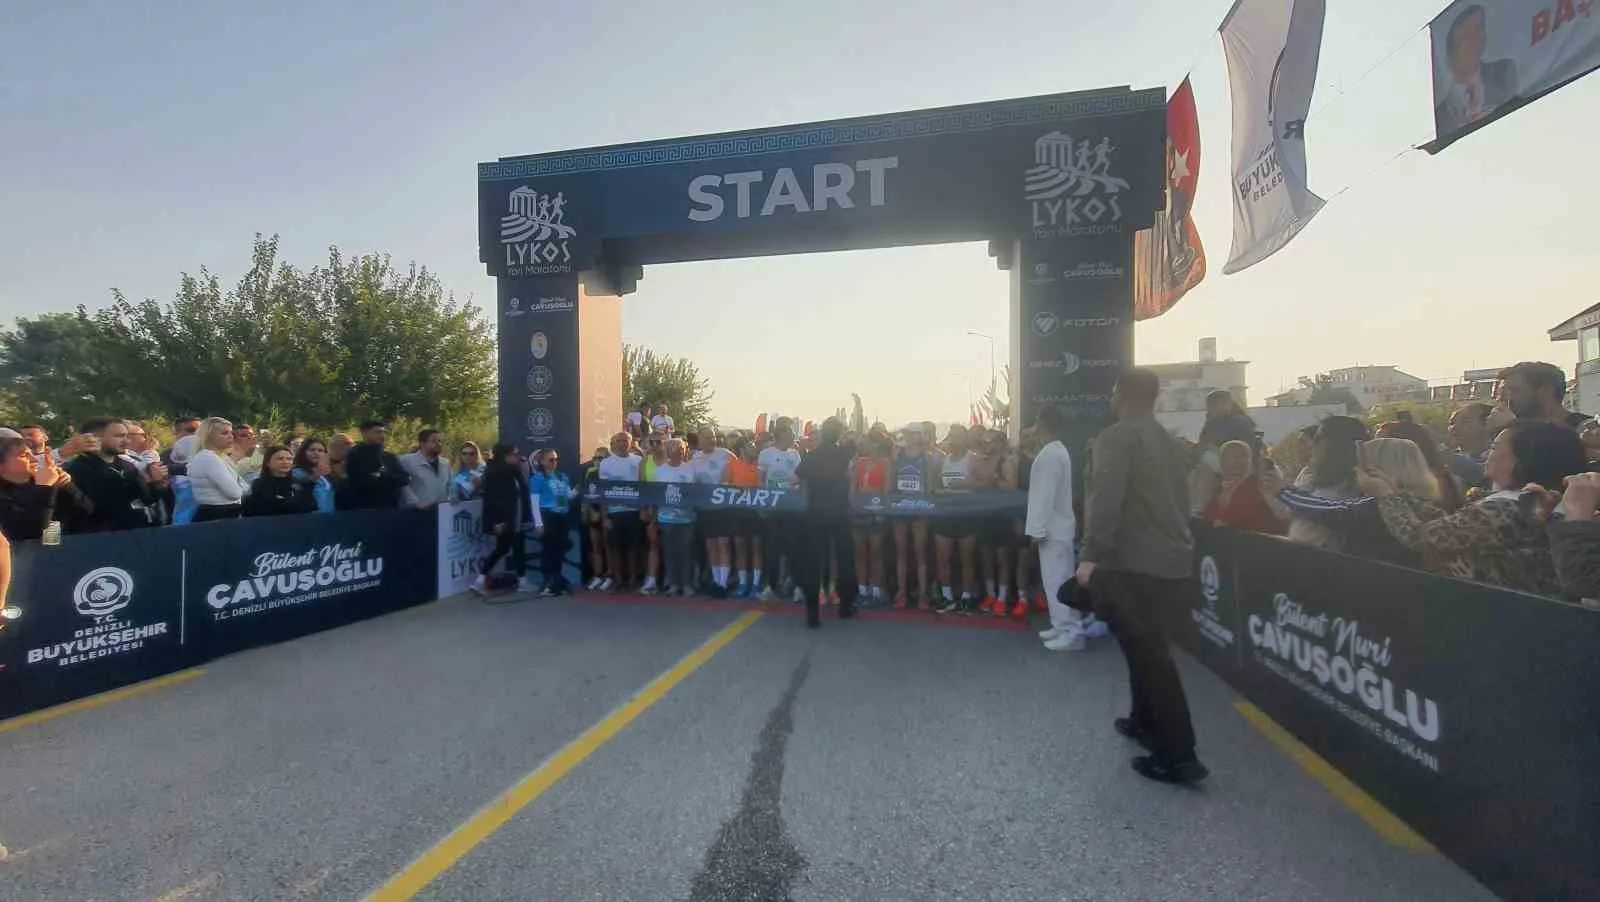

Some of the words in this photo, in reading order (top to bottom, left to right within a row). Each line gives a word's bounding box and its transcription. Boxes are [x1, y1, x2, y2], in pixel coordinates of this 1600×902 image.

[687, 155, 899, 222] START
[1032, 195, 1122, 227] LYKOS
[506, 240, 571, 266] LYKOS
[711, 487, 784, 507] START
[249, 549, 317, 577] Bülent
[320, 541, 362, 568] Nuri
[1332, 616, 1391, 667] Nuri
